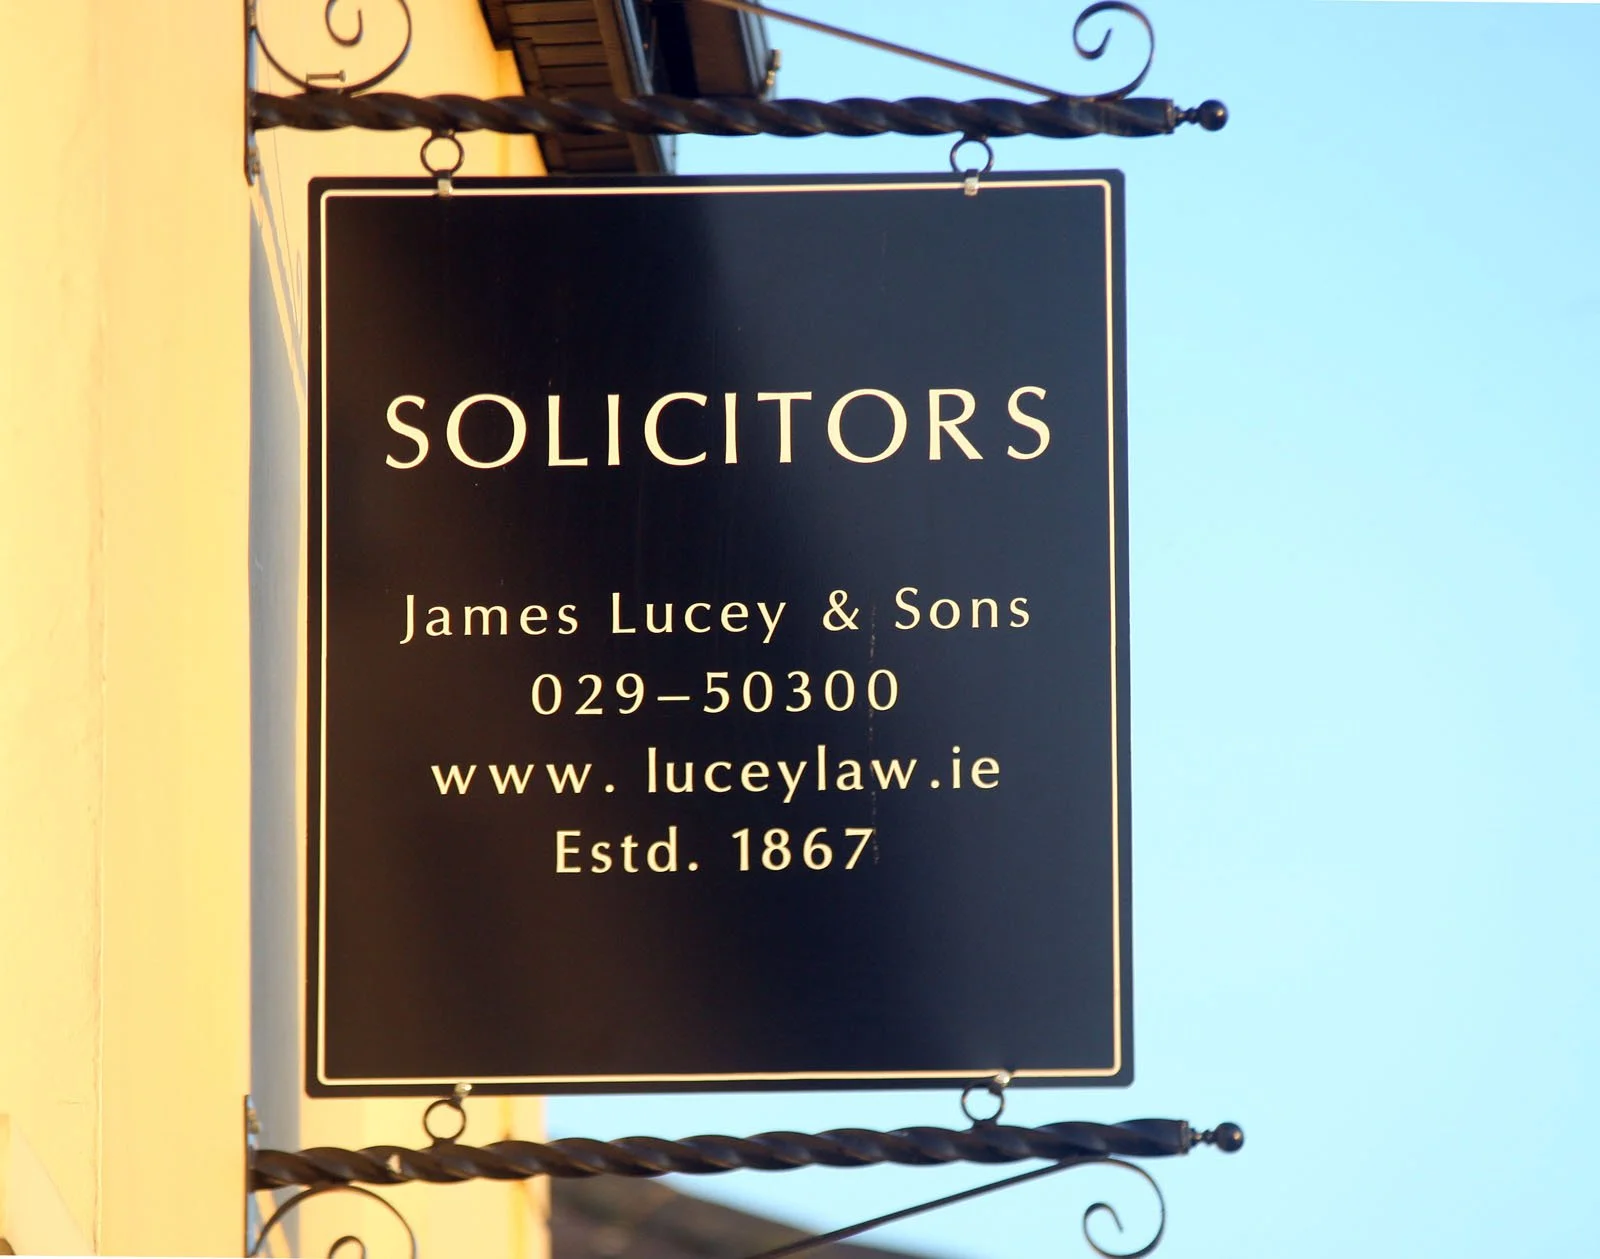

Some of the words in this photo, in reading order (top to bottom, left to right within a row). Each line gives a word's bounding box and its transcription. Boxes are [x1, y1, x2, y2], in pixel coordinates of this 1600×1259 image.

[385, 385, 1051, 470] SOLICITORS
[399, 594, 578, 645] James
[612, 592, 787, 644] Lucey
[822, 589, 860, 632] &
[894, 586, 1030, 630] Sons
[556, 825, 698, 874] Estd.
[732, 827, 875, 871] 1867
